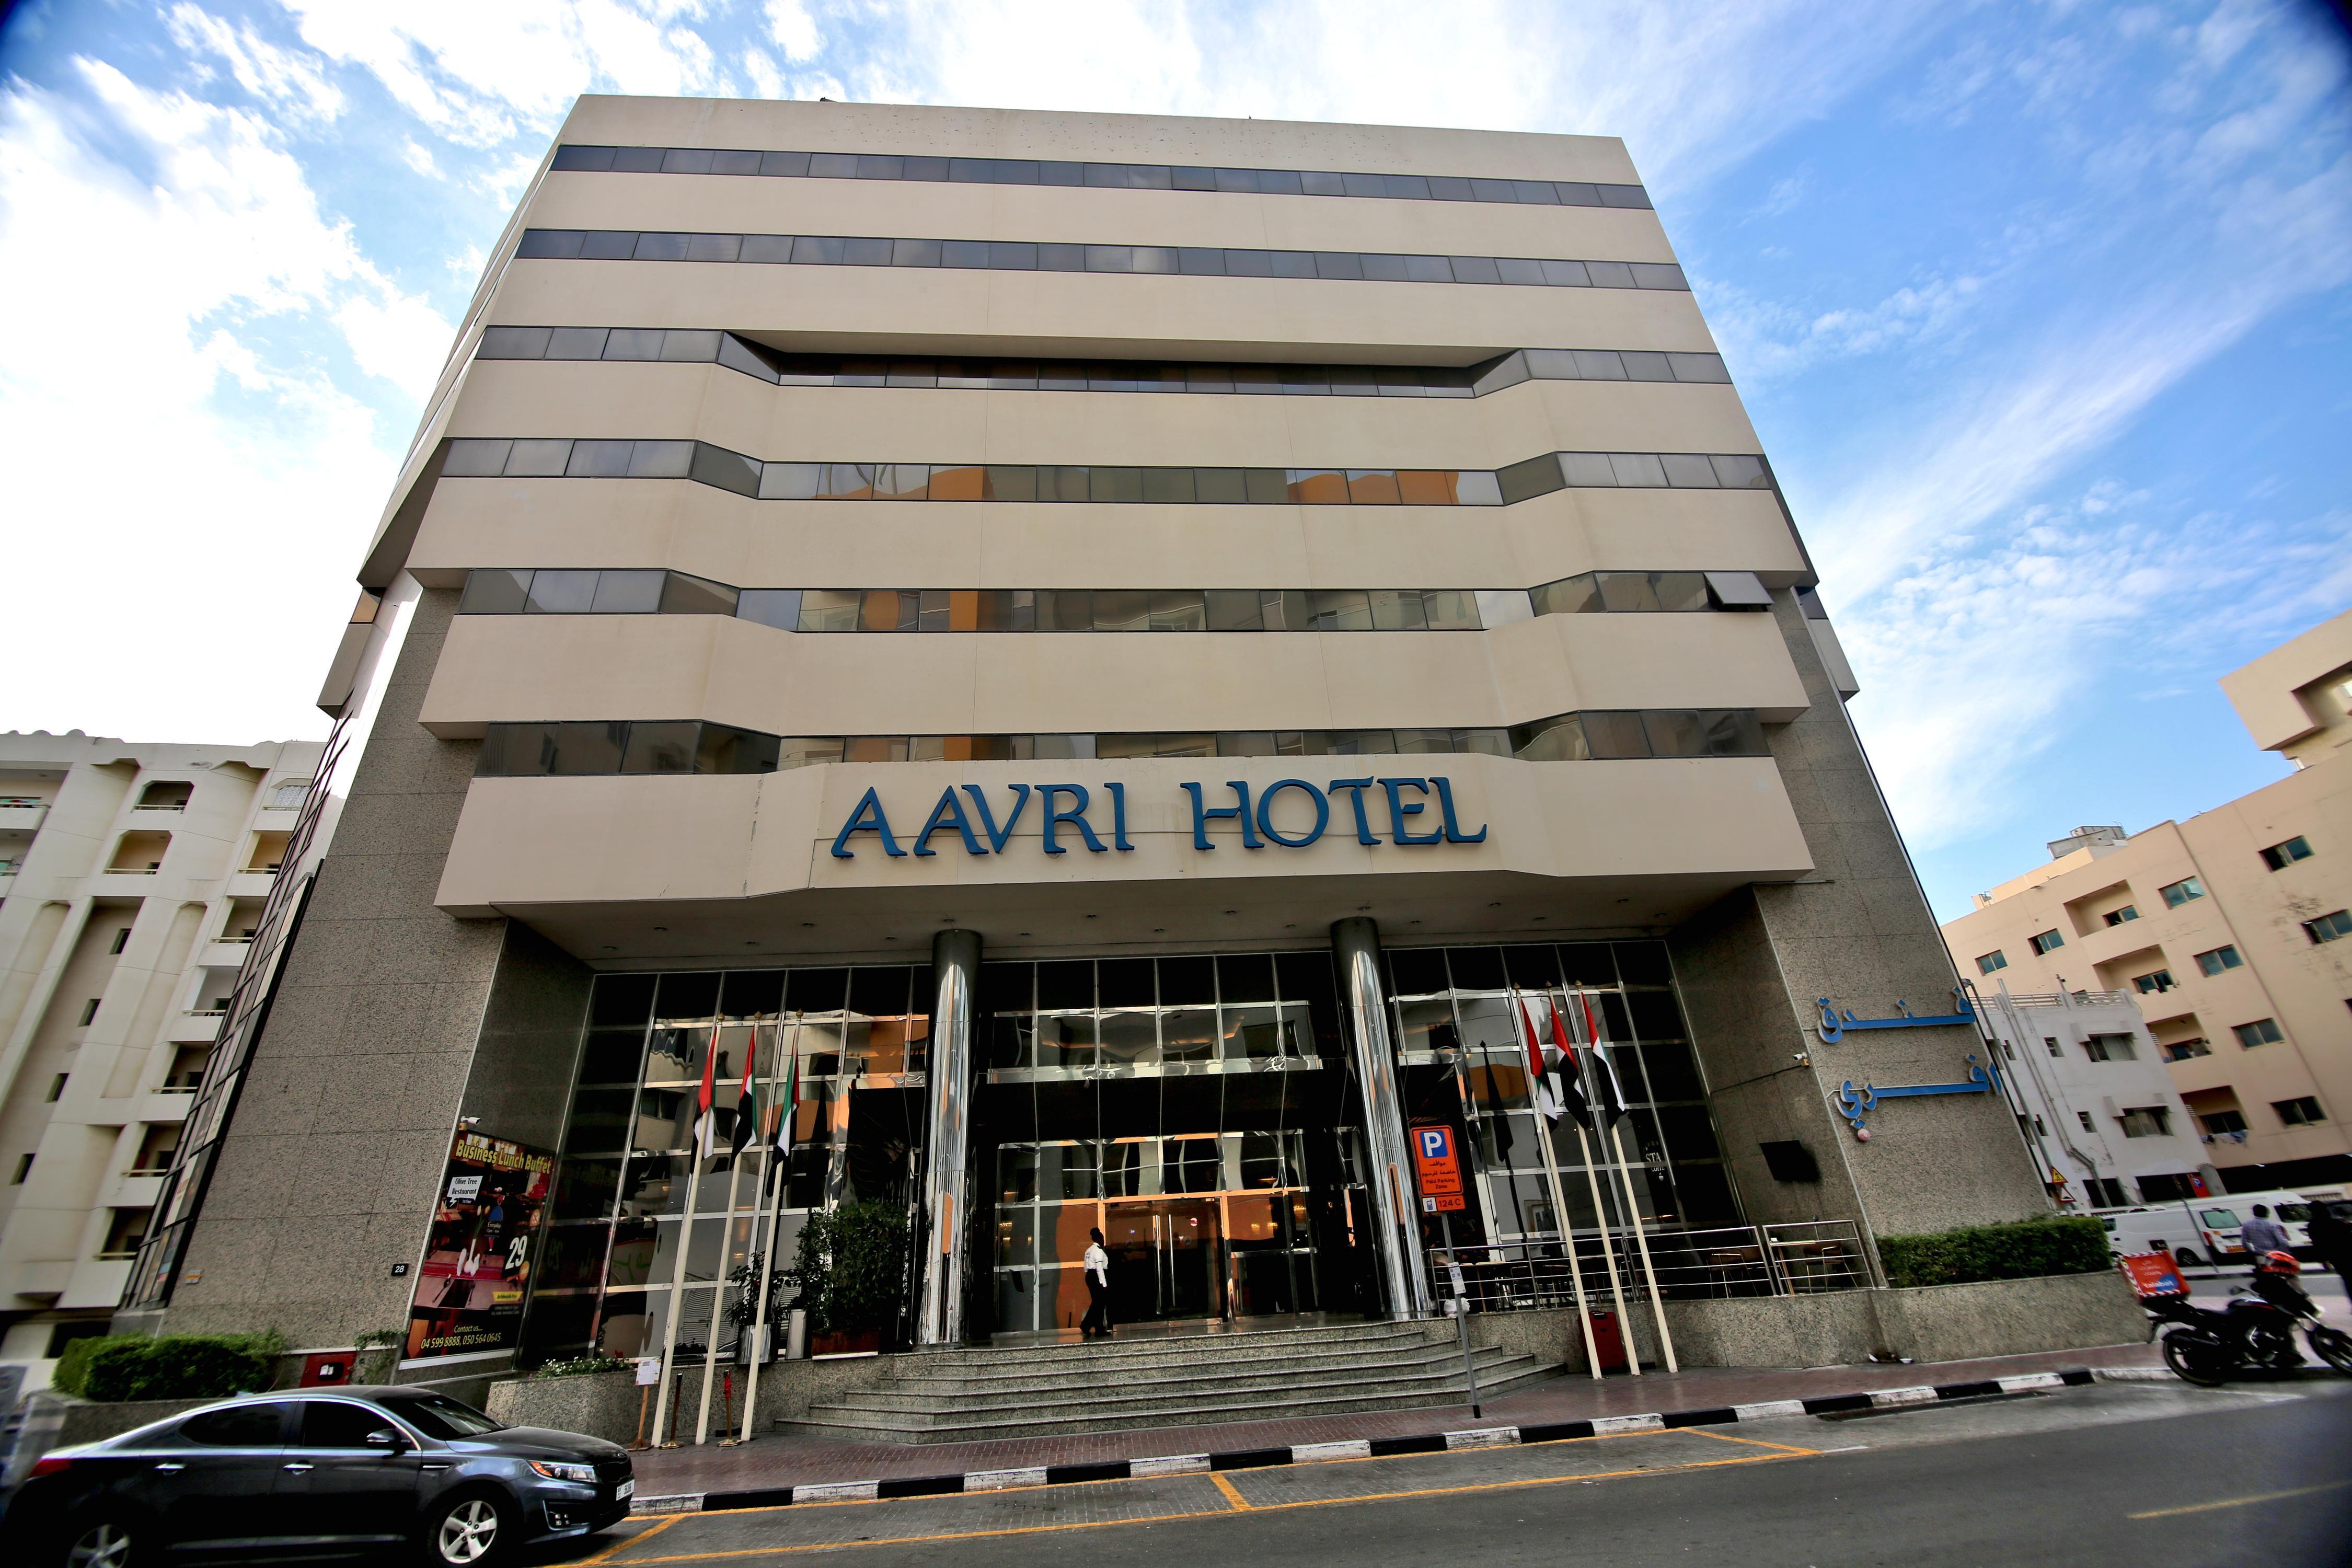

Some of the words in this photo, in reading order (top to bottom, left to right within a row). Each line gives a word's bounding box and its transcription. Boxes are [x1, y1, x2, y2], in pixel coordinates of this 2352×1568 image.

[831, 782, 1134, 859] AAVRI
[1180, 776, 1487, 851] HOTEL
[1818, 986, 1976, 1044] فندق
[456, 1139, 497, 1163] Business
[498, 1148, 524, 1169] Lunch
[525, 1154, 552, 1174] Buffet
[1424, 1132, 1442, 1157] P
[505, 1235, 528, 1270] 29
[421, 1339, 430, 1349] 04
[431, 1337, 444, 1348] 599
[444, 1336, 461, 1347] 8888,
[463, 1334, 475, 1345] 050
[475, 1333, 486, 1344] 564
[487, 1332, 502, 1342] 0645
